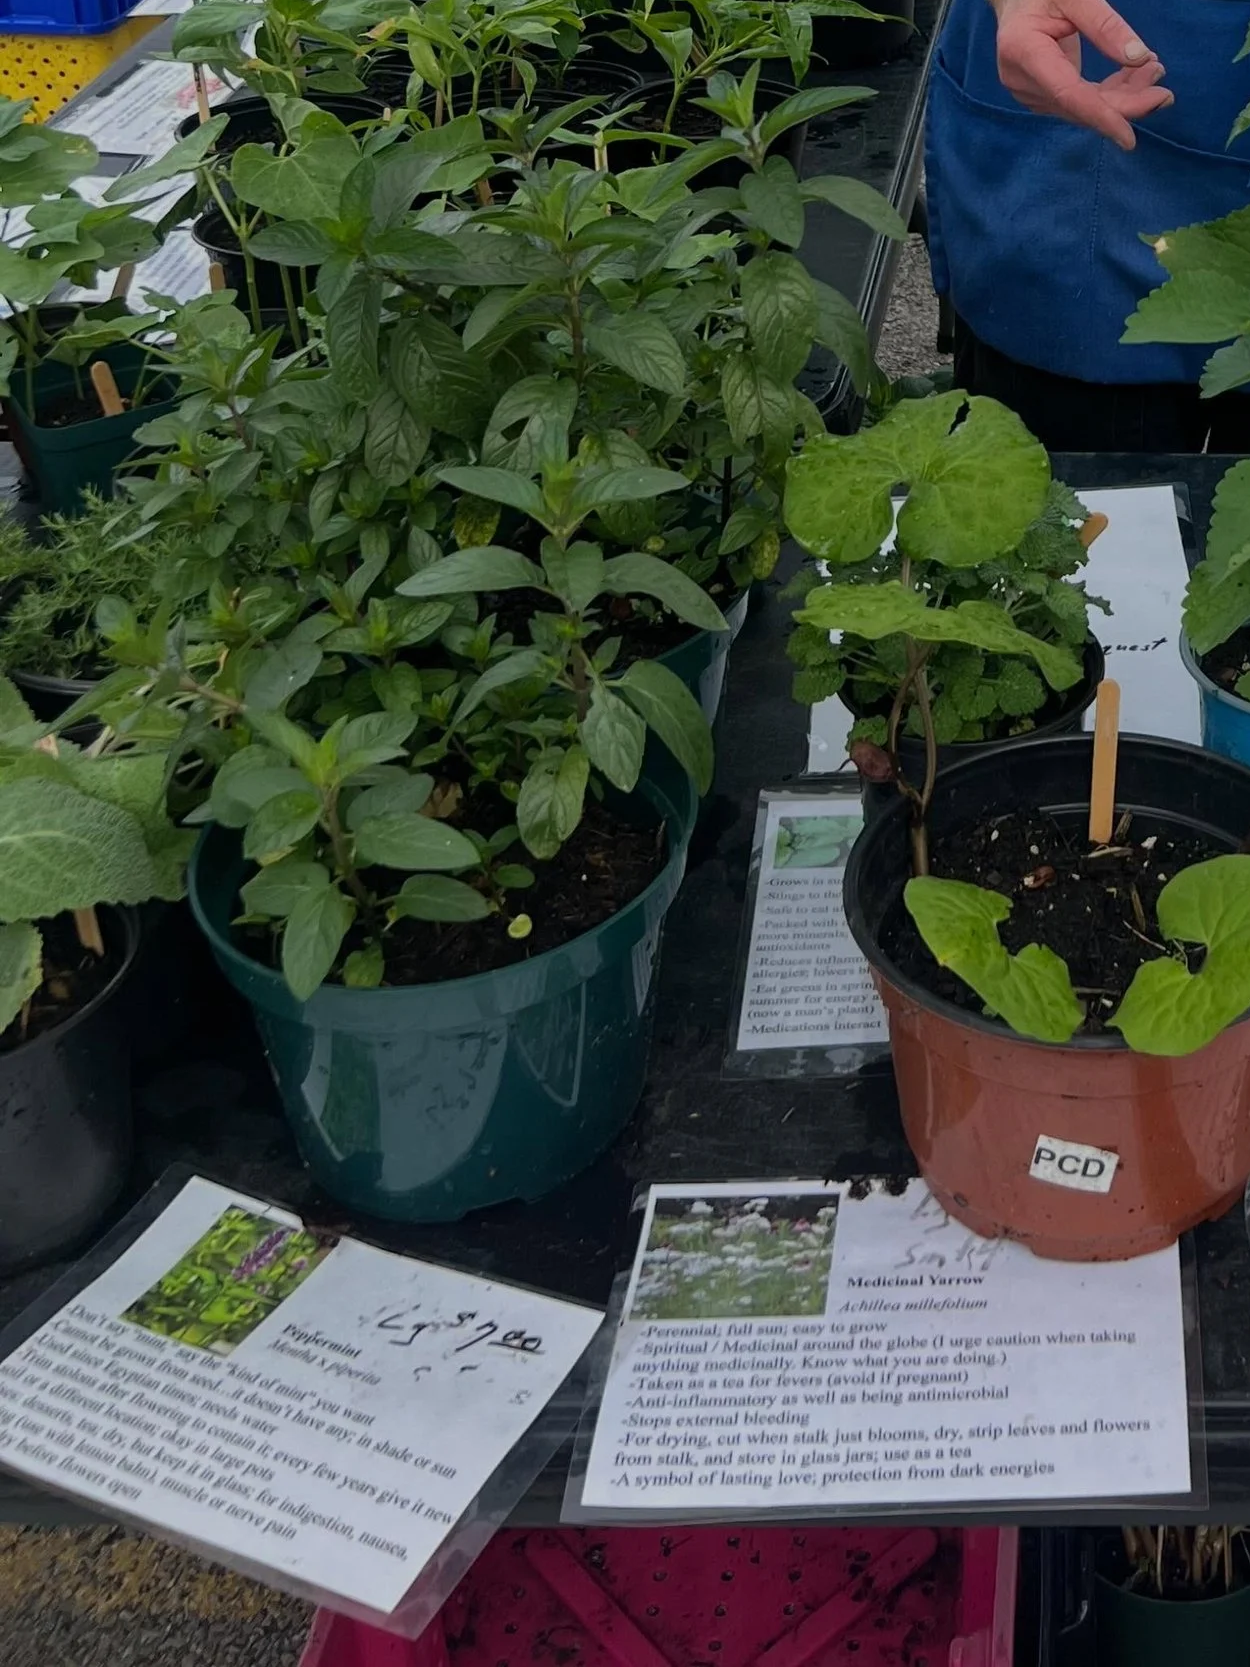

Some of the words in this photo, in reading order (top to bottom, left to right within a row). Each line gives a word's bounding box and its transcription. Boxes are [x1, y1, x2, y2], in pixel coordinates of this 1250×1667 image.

[1034, 1147, 1106, 1178] PCD
[847, 1274, 924, 1288] Medicinal
[929, 1273, 983, 1286] Yarrow
[839, 1298, 900, 1312] Achillea
[904, 1297, 987, 1311] millefolium
[726, 1322, 753, 1336] full
[791, 1324, 825, 1336] easy
[829, 1322, 845, 1334] to
[848, 1322, 887, 1335] grow
[675, 1411, 739, 1427] external
[742, 1410, 809, 1427] bleeding
[634, 1470, 694, 1490] symbol
[697, 1470, 716, 1486] of
[719, 1469, 772, 1489] lasting
[820, 1464, 902, 1487] protection
[907, 1465, 945, 1480] from
[949, 1462, 984, 1478] dark
[989, 1460, 1054, 1478] energies
